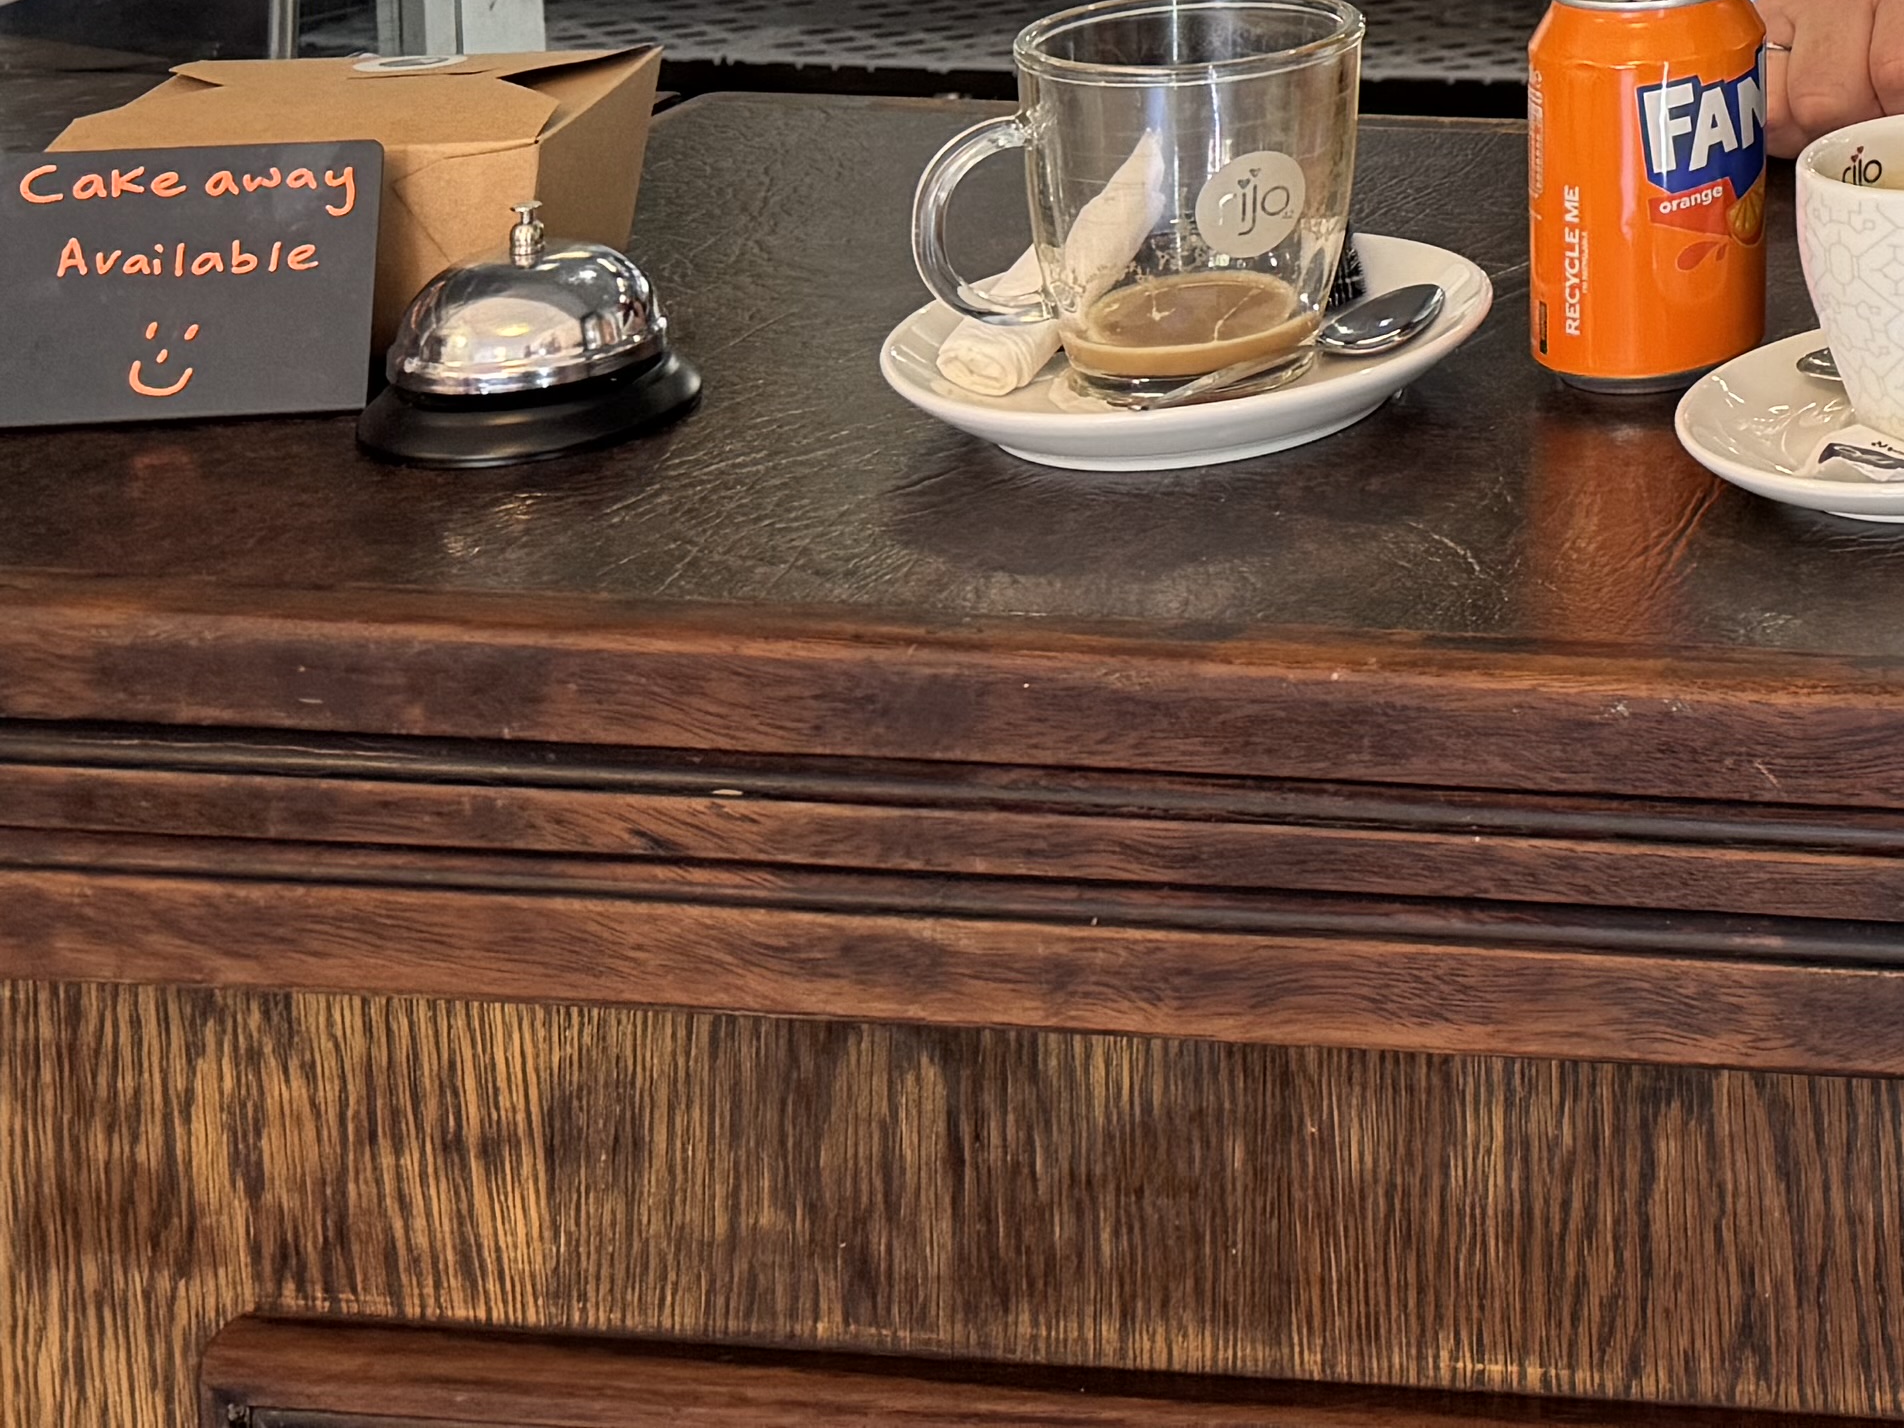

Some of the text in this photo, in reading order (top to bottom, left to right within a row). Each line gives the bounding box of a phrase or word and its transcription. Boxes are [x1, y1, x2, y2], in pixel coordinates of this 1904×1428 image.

[1643, 52, 1766, 172] FAN
[19, 161, 358, 218] Cake away
[1217, 167, 1292, 236] rijo
[1659, 184, 1724, 215] orange
[56, 235, 320, 279] Available
[1563, 185, 1581, 337] RECYCLE ME
